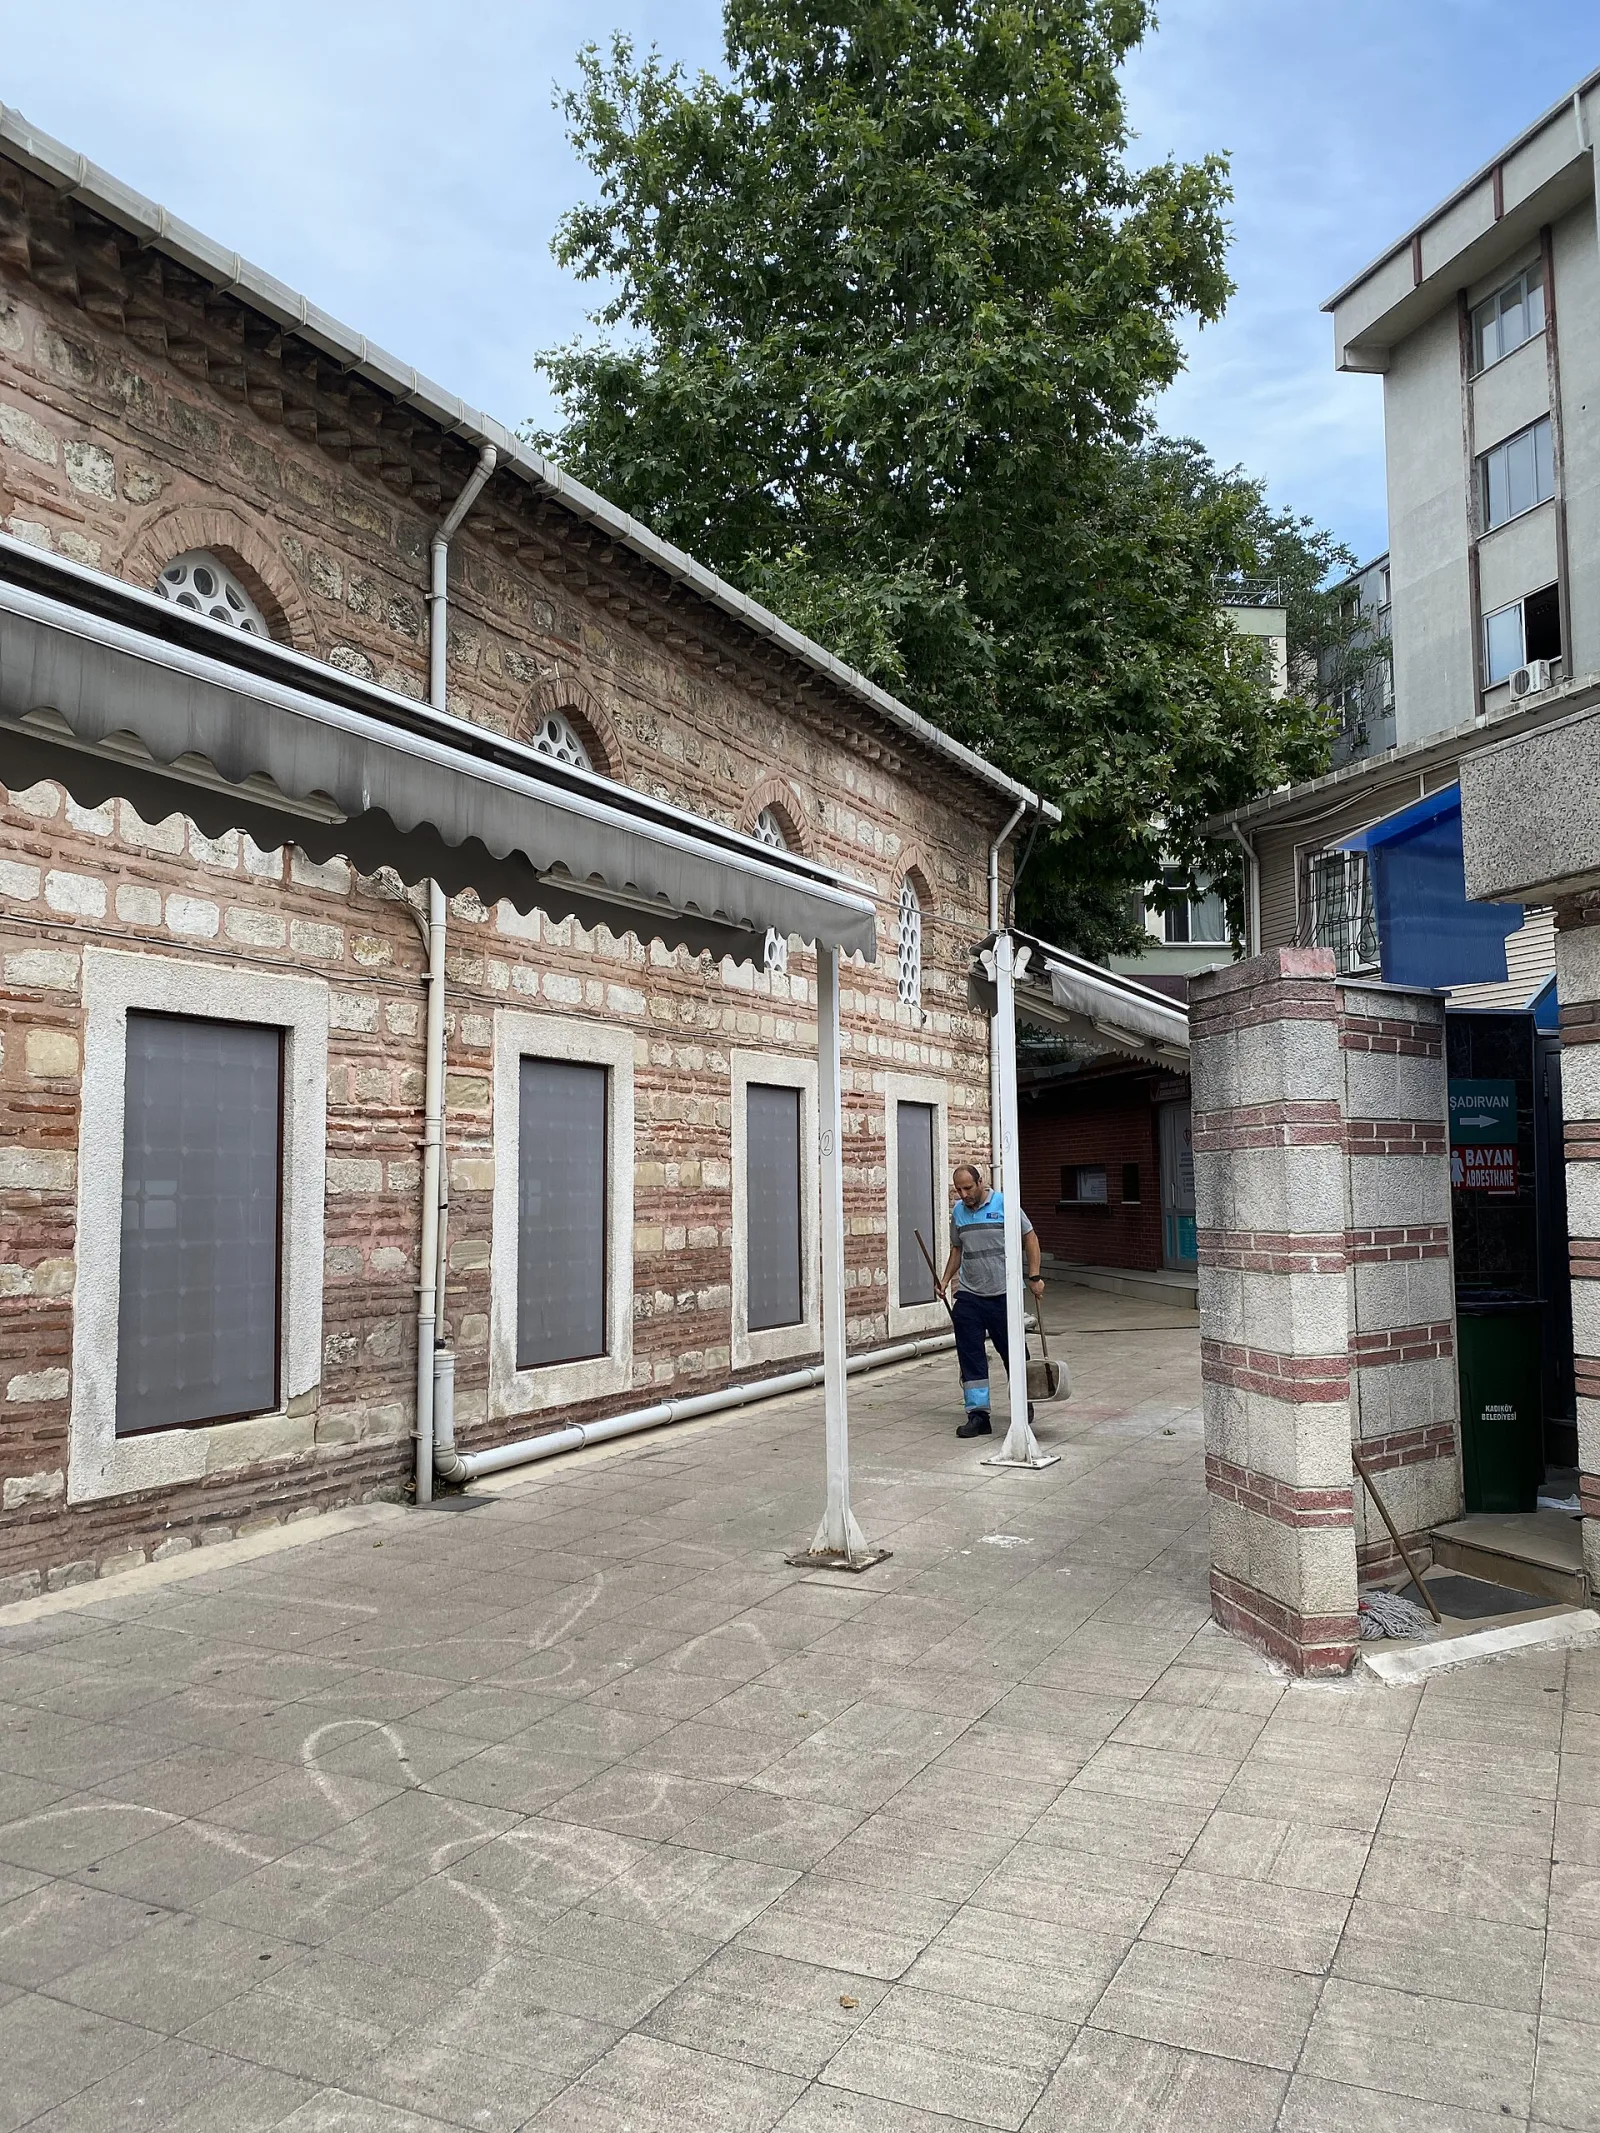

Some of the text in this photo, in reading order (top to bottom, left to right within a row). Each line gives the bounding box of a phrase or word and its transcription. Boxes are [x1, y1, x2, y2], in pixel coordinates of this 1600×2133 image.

[1450, 1096, 1509, 1111] ŞADIRVAN
[1465, 1149, 1513, 1166] BAYAN
[1466, 1169, 1514, 1187] ABDESTHANE
[1485, 1404, 1513, 1412] KADIKÖY
[1481, 1412, 1517, 1421] BELEDİYESİ
